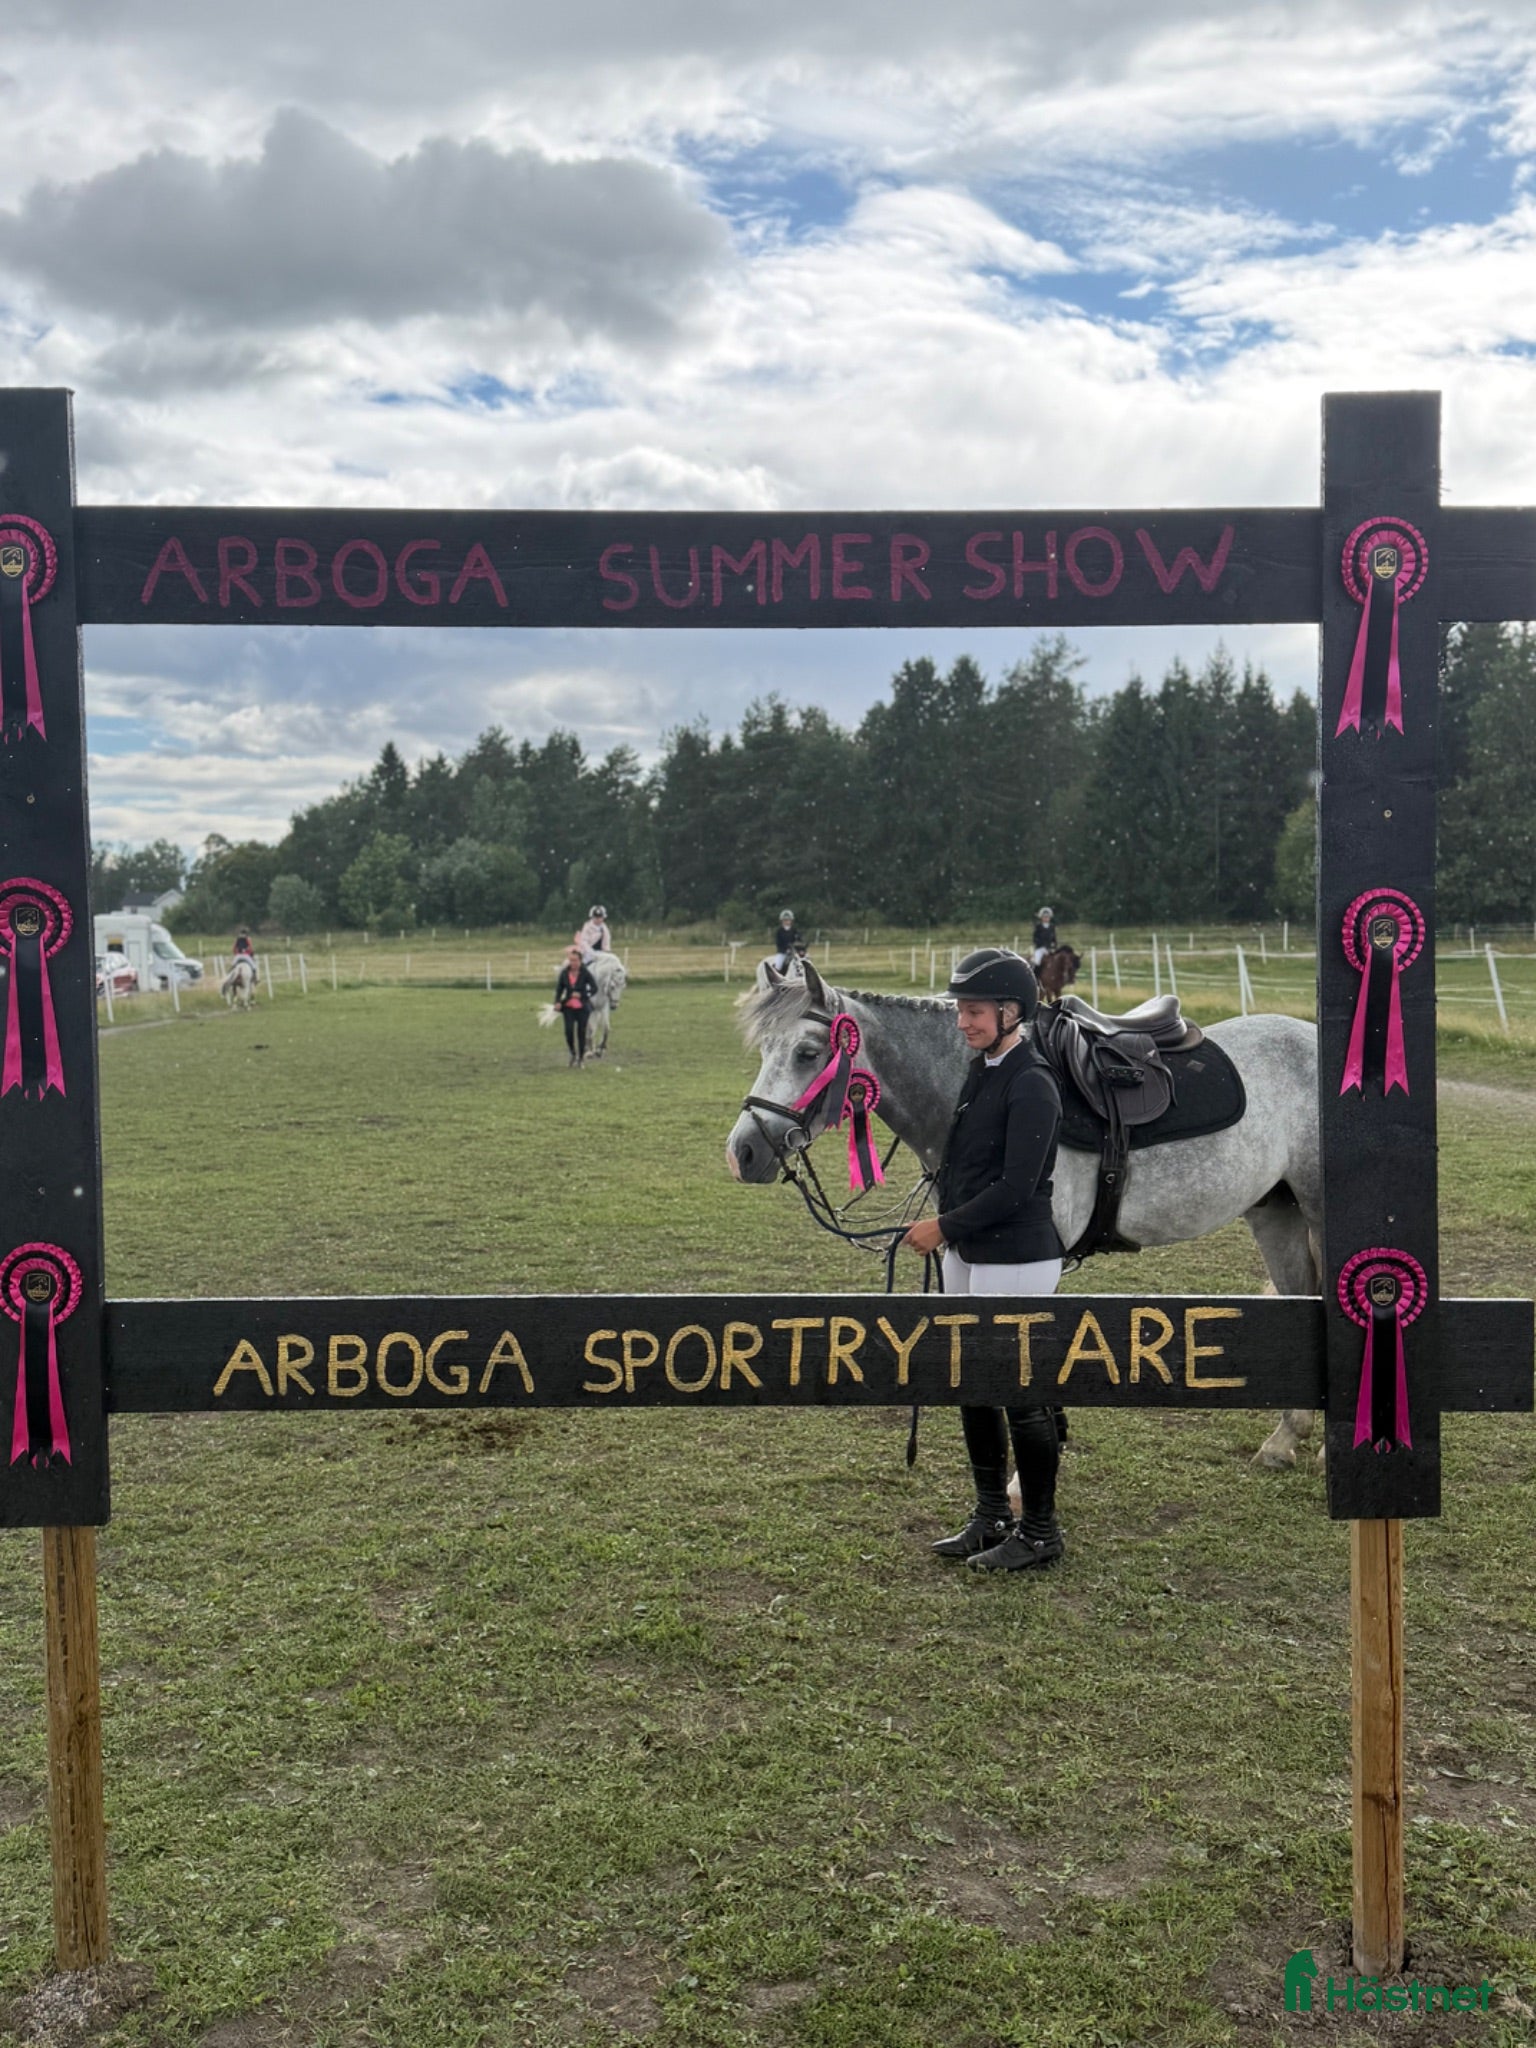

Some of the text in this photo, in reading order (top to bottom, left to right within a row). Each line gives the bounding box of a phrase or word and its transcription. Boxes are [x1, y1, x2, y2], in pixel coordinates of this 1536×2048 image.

[141, 525, 1234, 611] ARBOGA SUMMER SHOW
[213, 1306, 1247, 1397] ARBOGA SPORTRYTTARE
